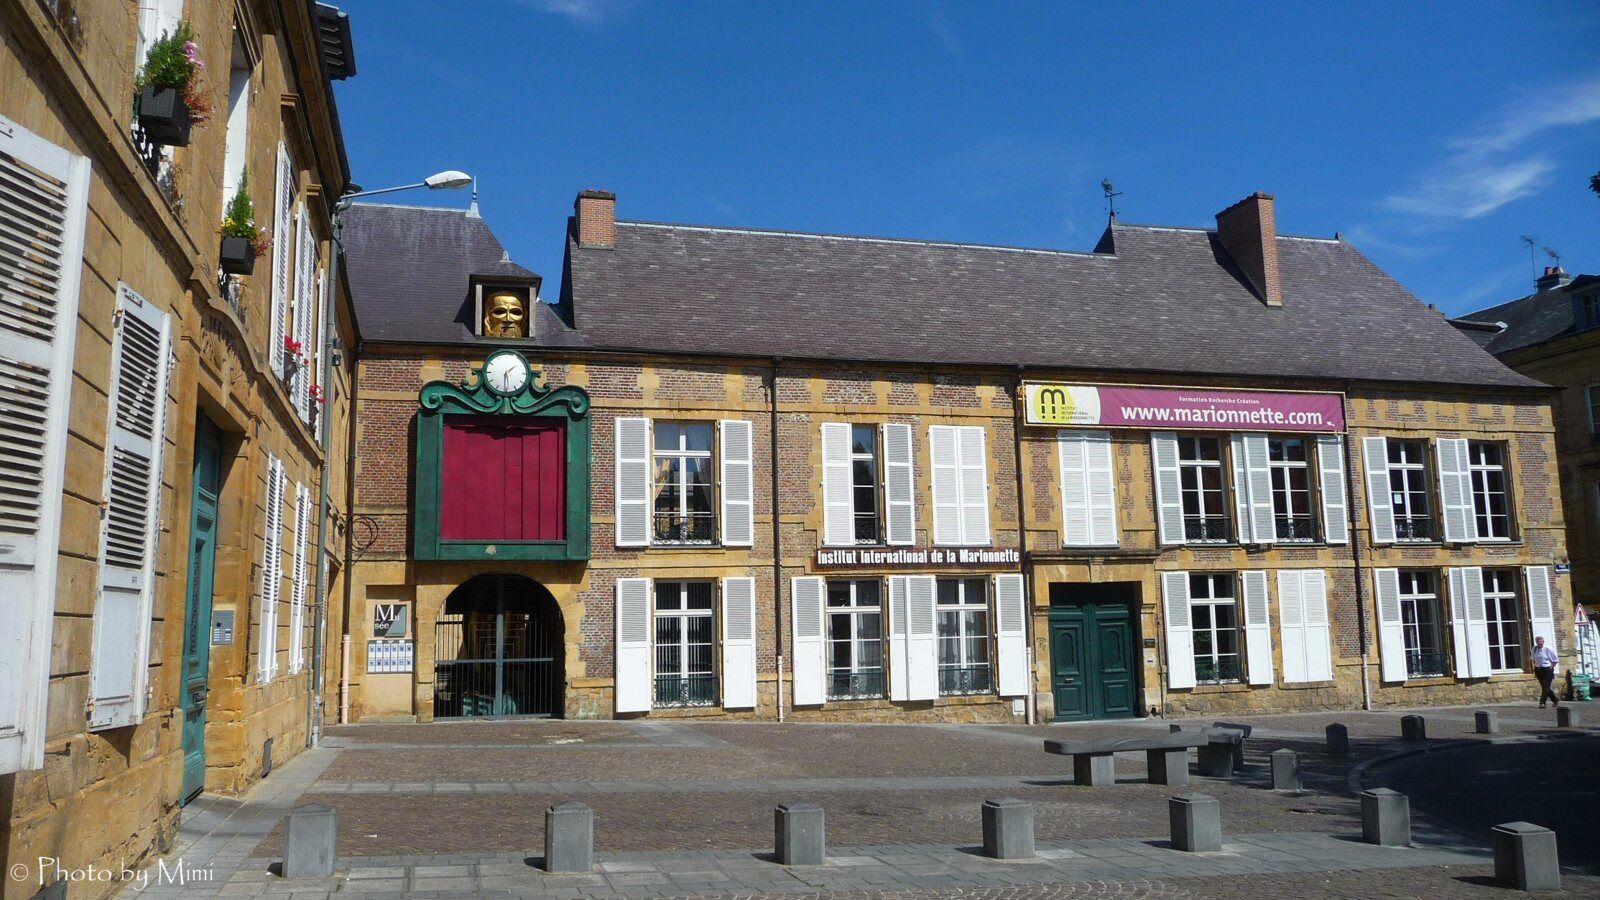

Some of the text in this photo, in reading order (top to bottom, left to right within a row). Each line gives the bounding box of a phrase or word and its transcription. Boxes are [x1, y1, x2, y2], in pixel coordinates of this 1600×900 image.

[1121, 406, 1322, 425] www.marionnette.com
[817, 549, 1019, 564] Institut International de la Marionnette
